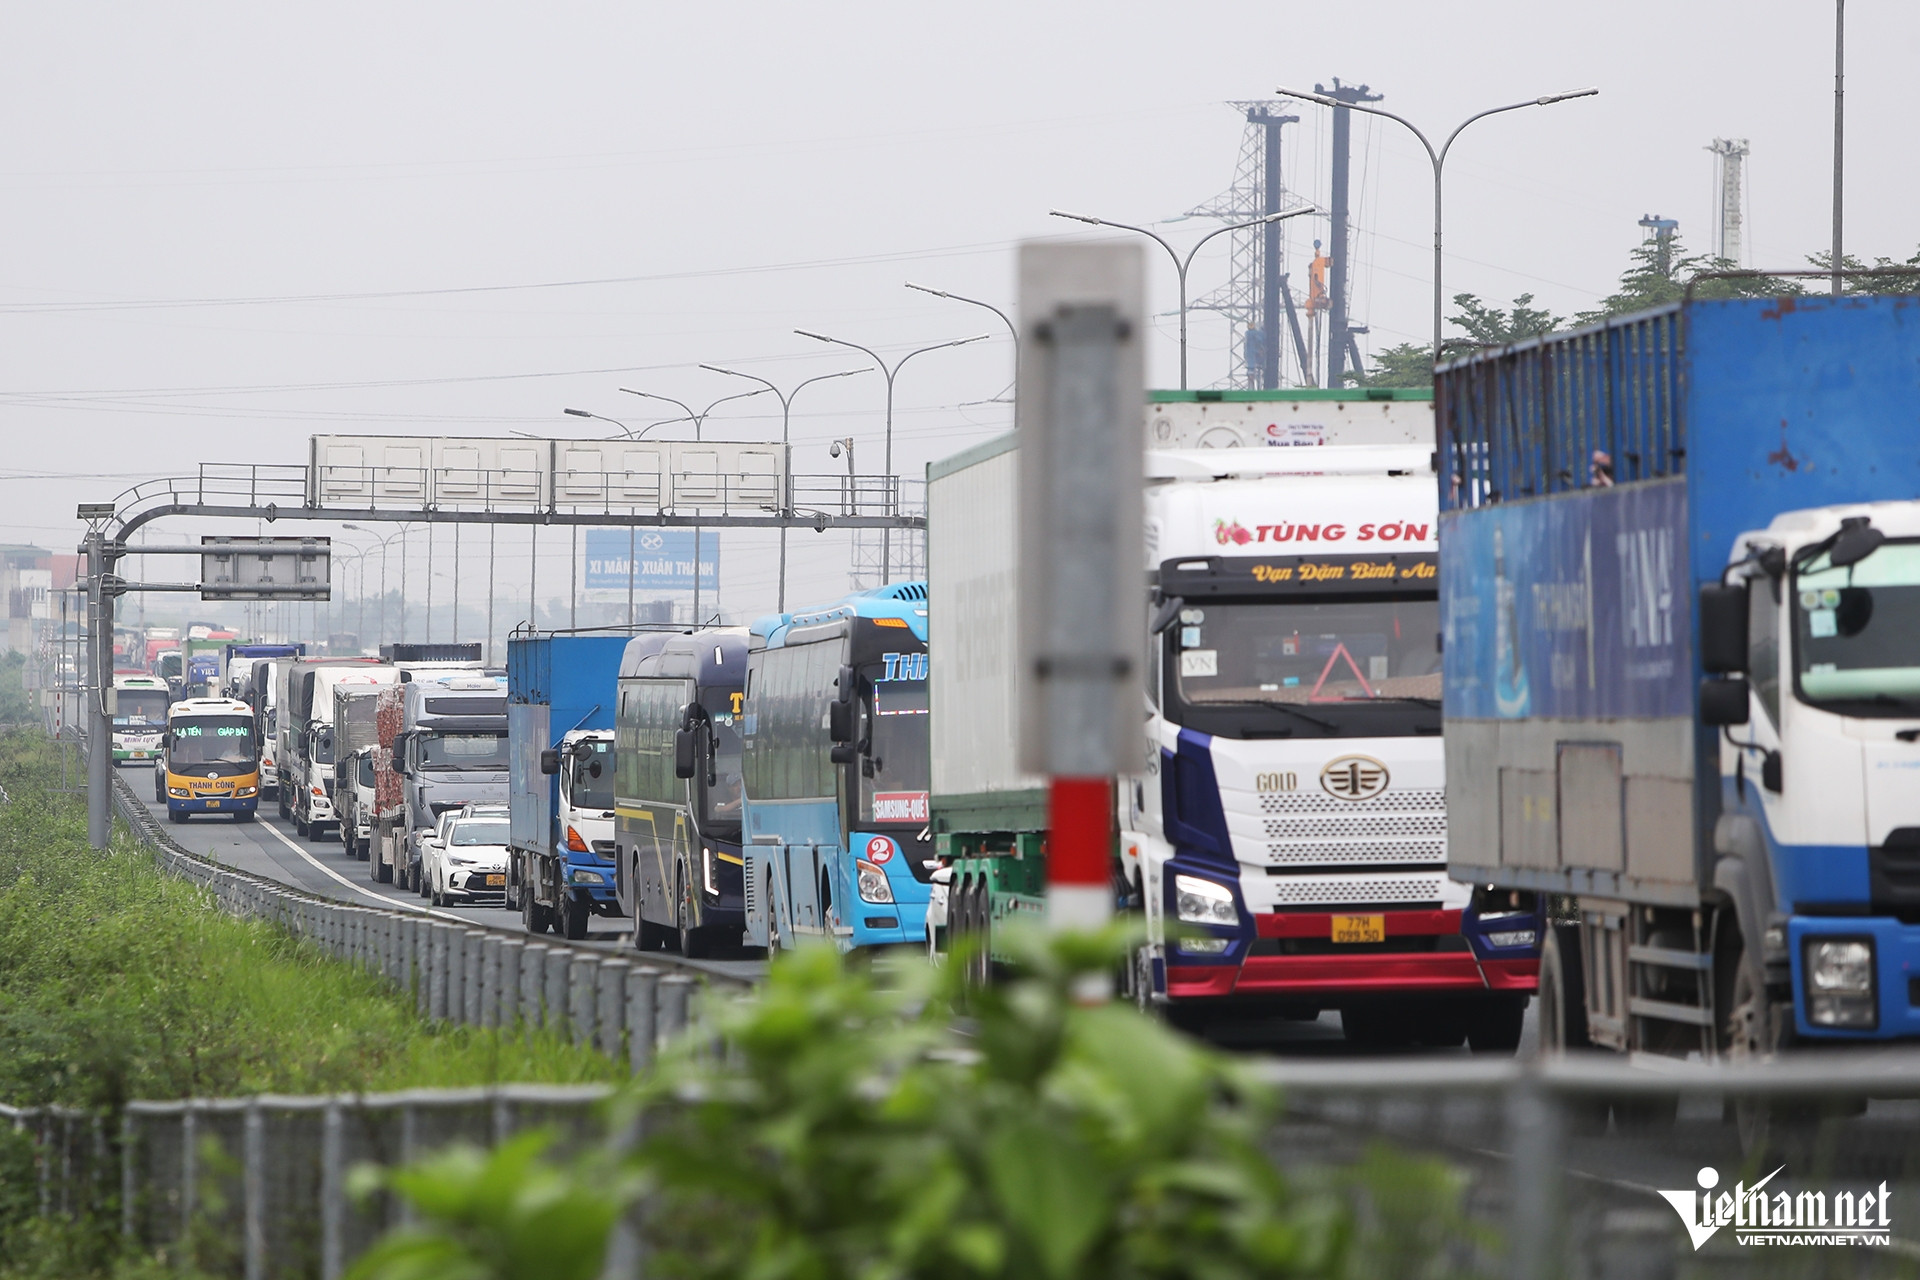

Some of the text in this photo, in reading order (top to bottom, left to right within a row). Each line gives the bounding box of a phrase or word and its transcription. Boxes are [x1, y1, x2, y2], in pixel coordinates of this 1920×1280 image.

[1256, 520, 1428, 542] TÙNG SƠN
[641, 557, 673, 575] XUÂN
[1252, 564, 1293, 584] Vạn
[1350, 561, 1396, 580] Bình
[1401, 561, 1437, 578] An
[189, 781, 236, 789] THÀNH CÔNG
[1256, 772, 1297, 793] GOLD
[871, 838, 890, 861] 2
